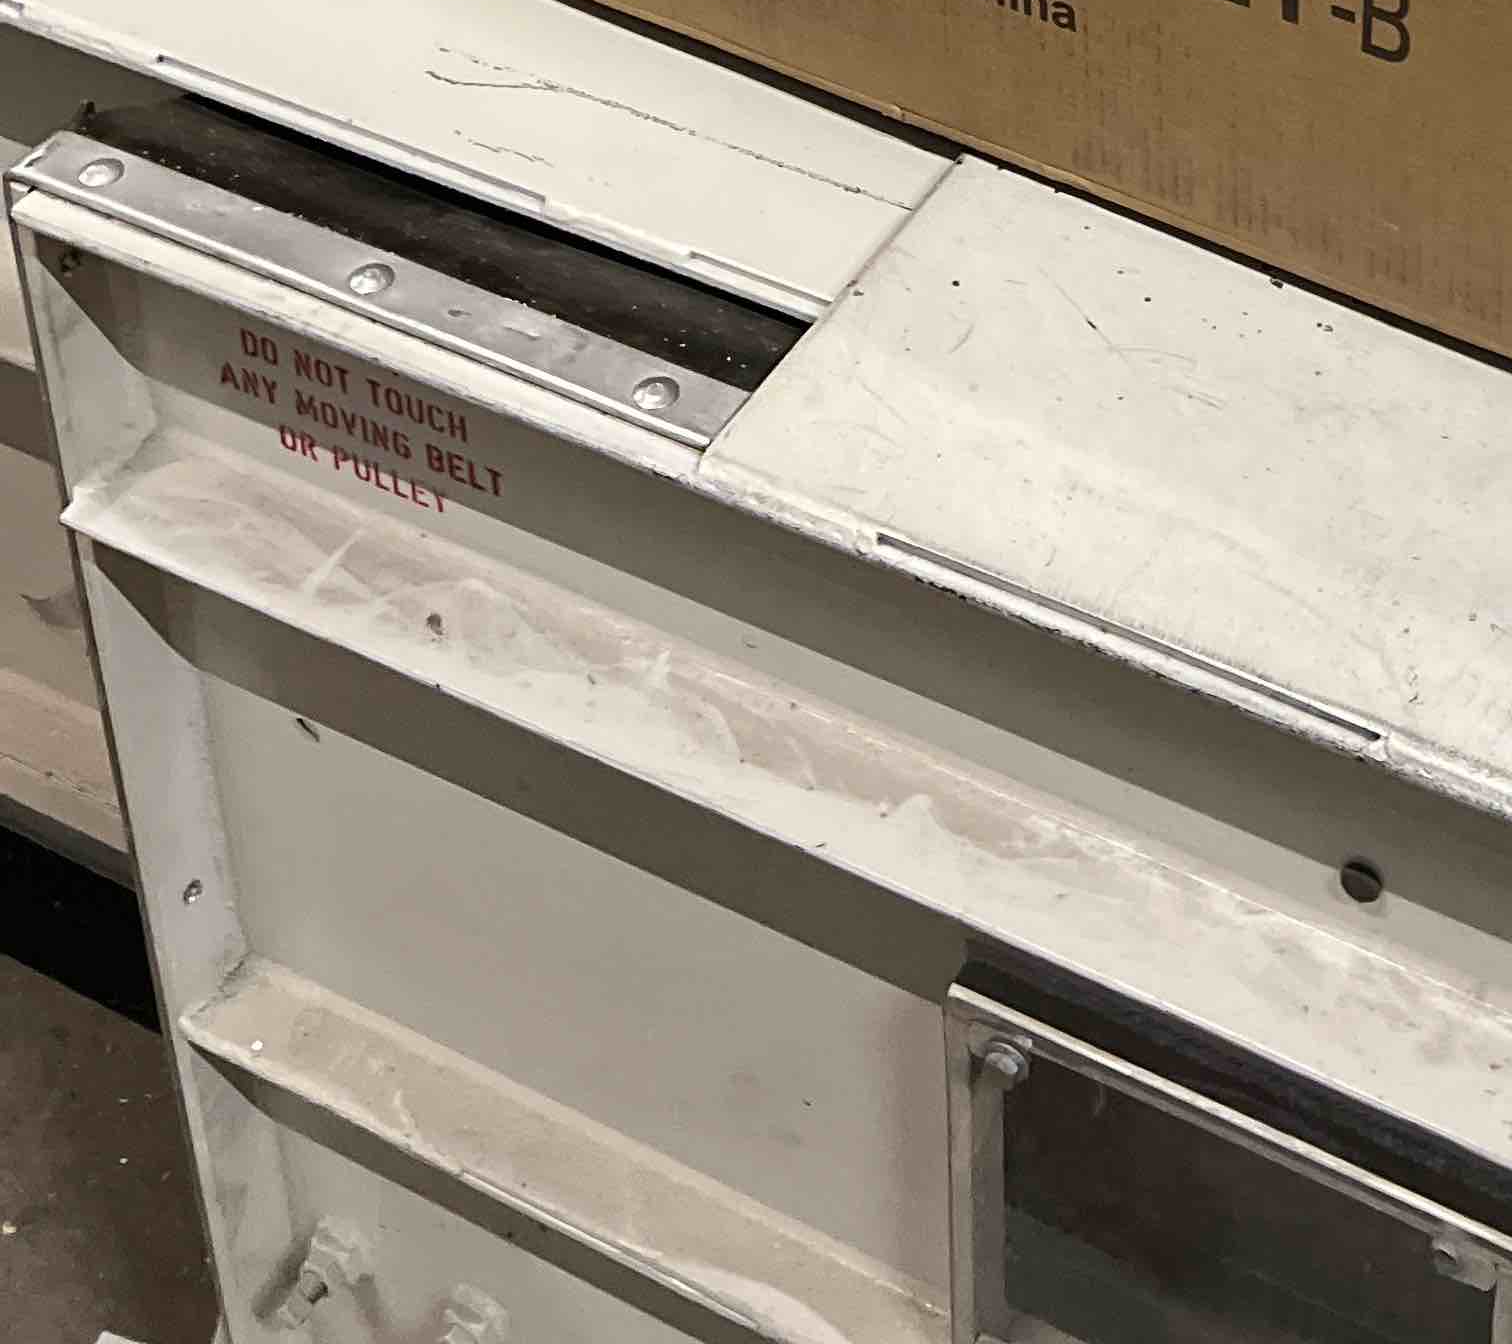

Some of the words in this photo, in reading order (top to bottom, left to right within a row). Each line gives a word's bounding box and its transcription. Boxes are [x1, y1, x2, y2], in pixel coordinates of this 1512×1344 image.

[219, 361, 278, 405] ANY
[294, 389, 413, 460] MOVING
[425, 443, 504, 497] BELT
[239, 328, 279, 366] DO
[295, 350, 350, 395] NOT
[366, 378, 469, 444] TOUCH
[277, 425, 320, 462] OR
[332, 446, 447, 513] PULLEY
